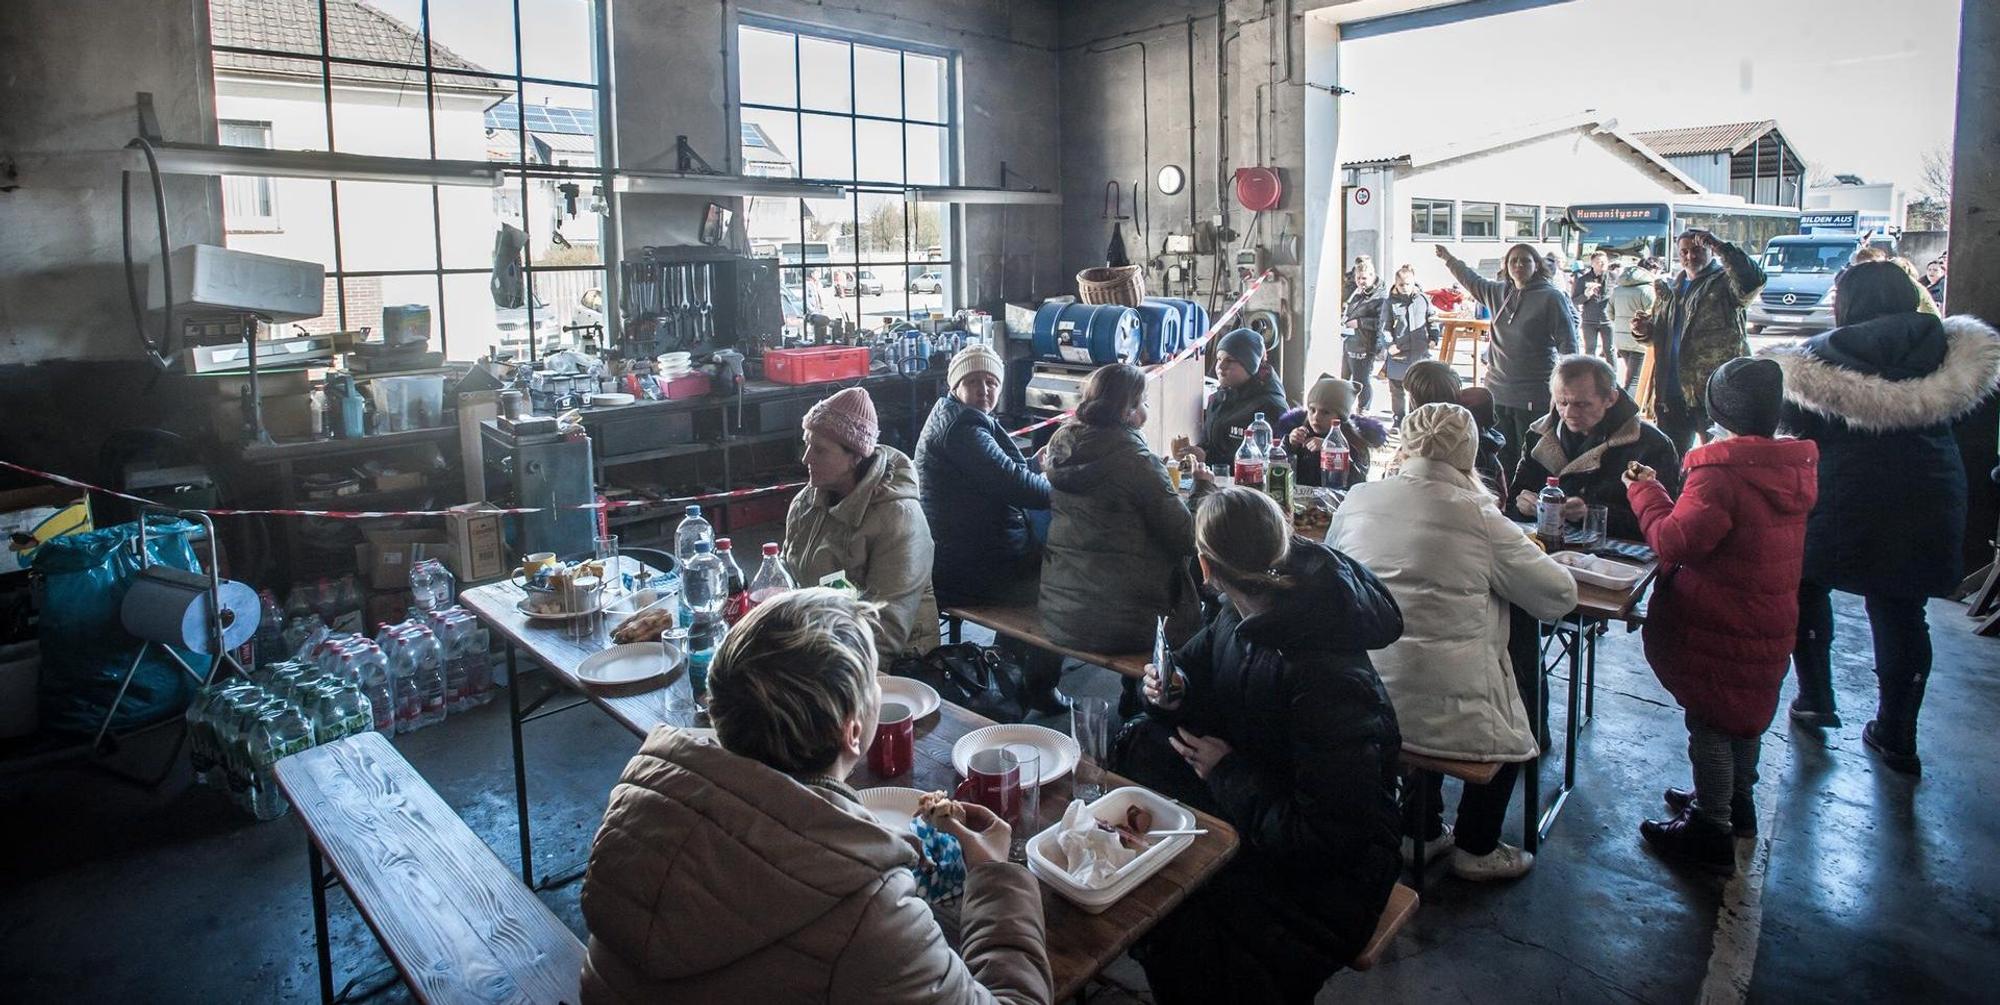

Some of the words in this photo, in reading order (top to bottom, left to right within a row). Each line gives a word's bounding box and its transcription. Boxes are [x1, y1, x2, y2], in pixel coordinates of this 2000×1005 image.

[1577, 208, 1651, 220] Humanitycare
[1800, 215, 1833, 223] BILDEN
[1833, 215, 1853, 223] AUS
